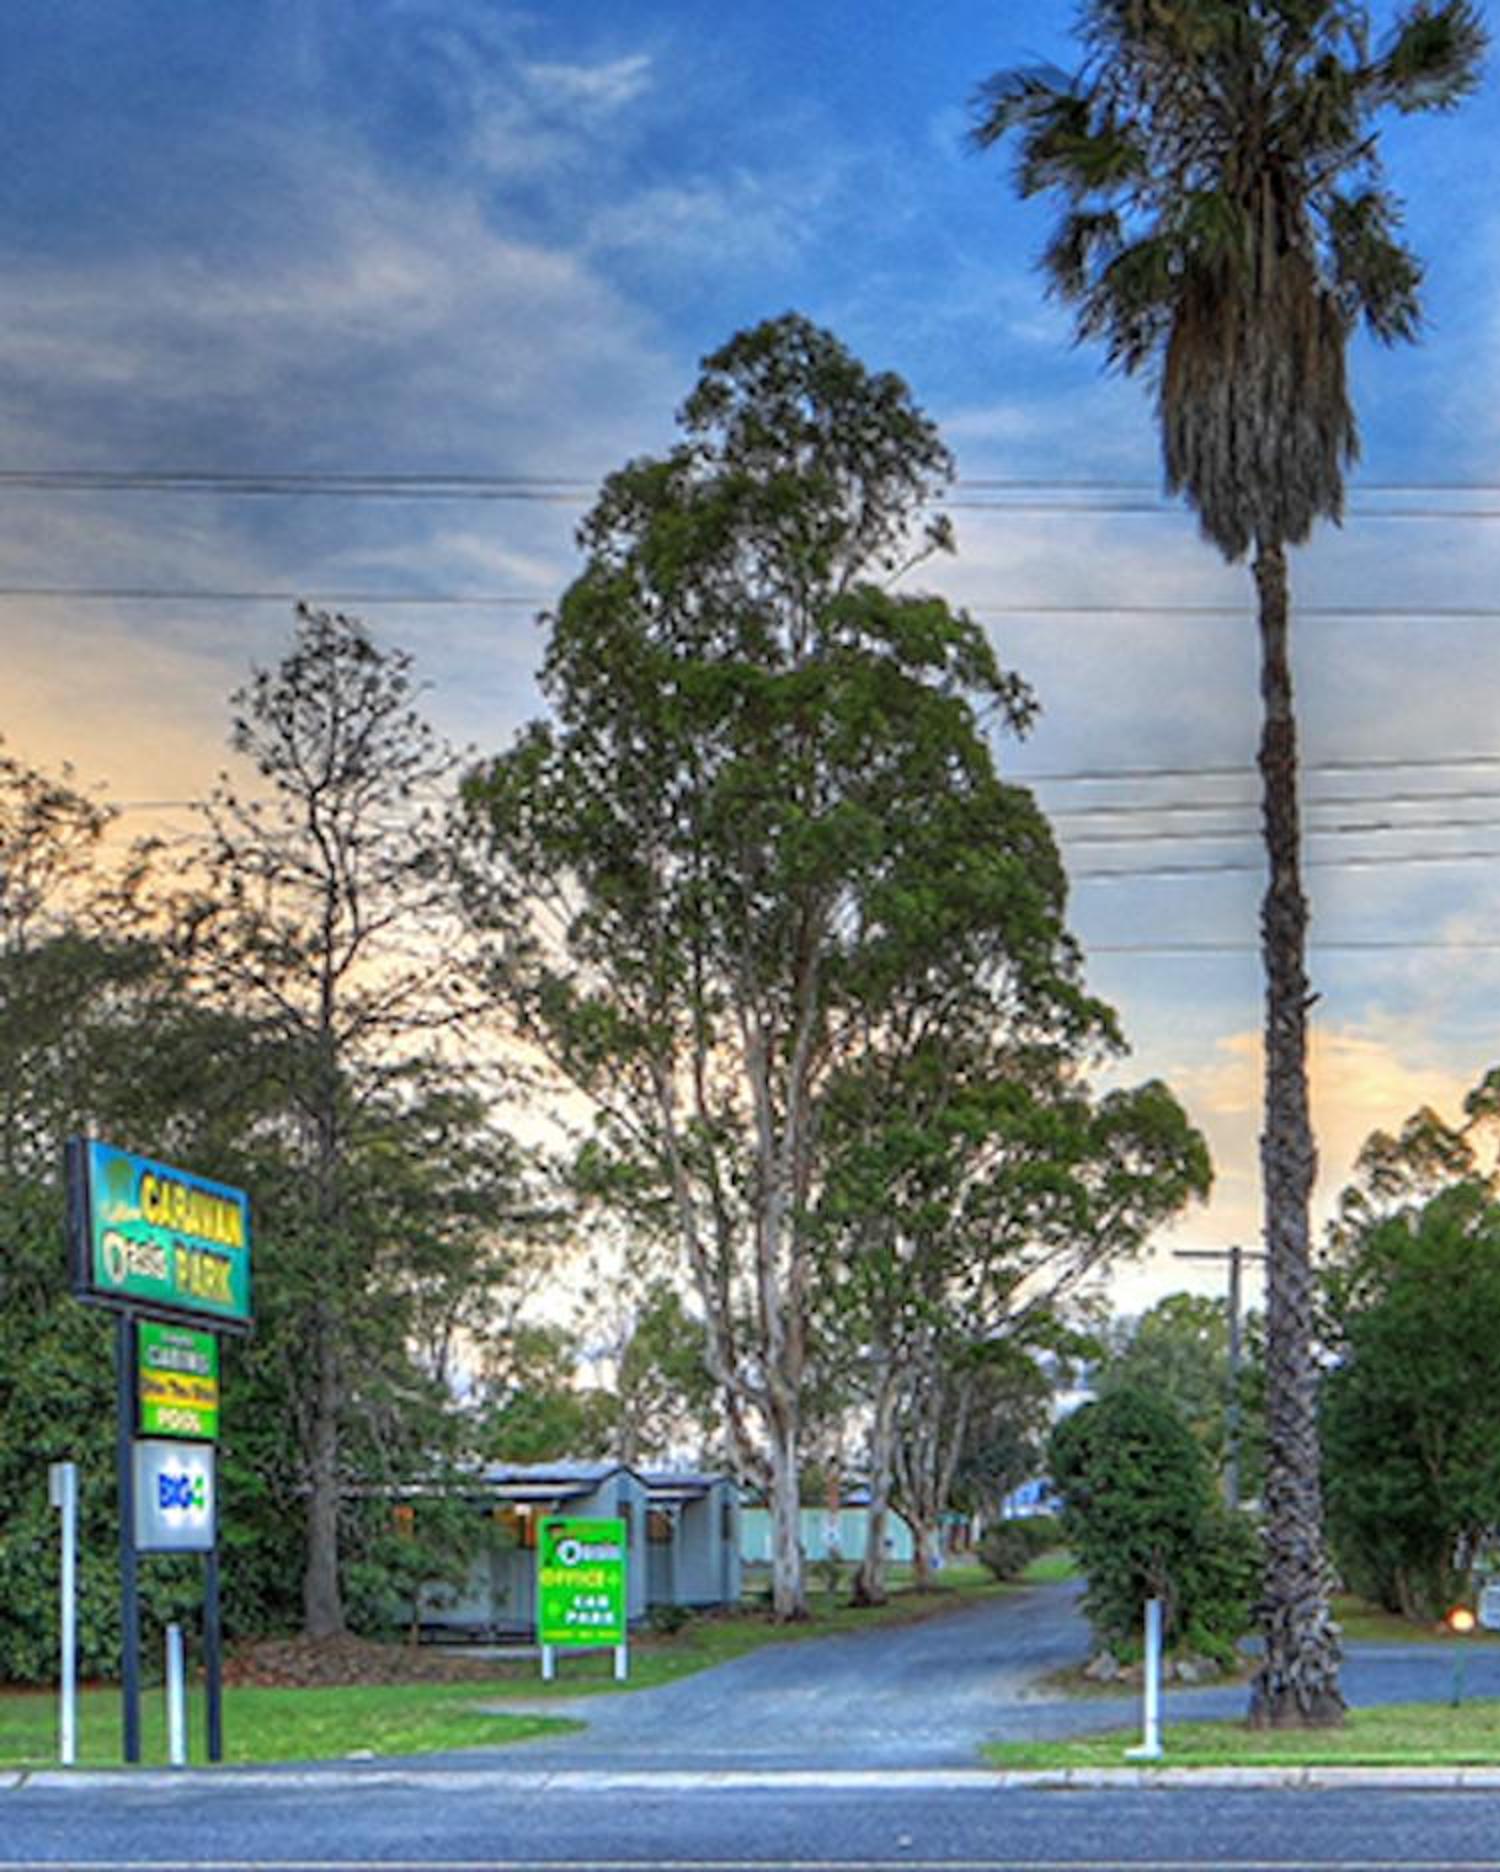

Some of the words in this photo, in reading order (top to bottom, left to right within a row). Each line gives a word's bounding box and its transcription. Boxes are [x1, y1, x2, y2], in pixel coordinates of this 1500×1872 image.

[140, 1172, 244, 1248] CARAVAN
[103, 1231, 168, 1284] Oasis
[174, 1246, 234, 1304] PARK
[565, 1611, 615, 1625] PARK
